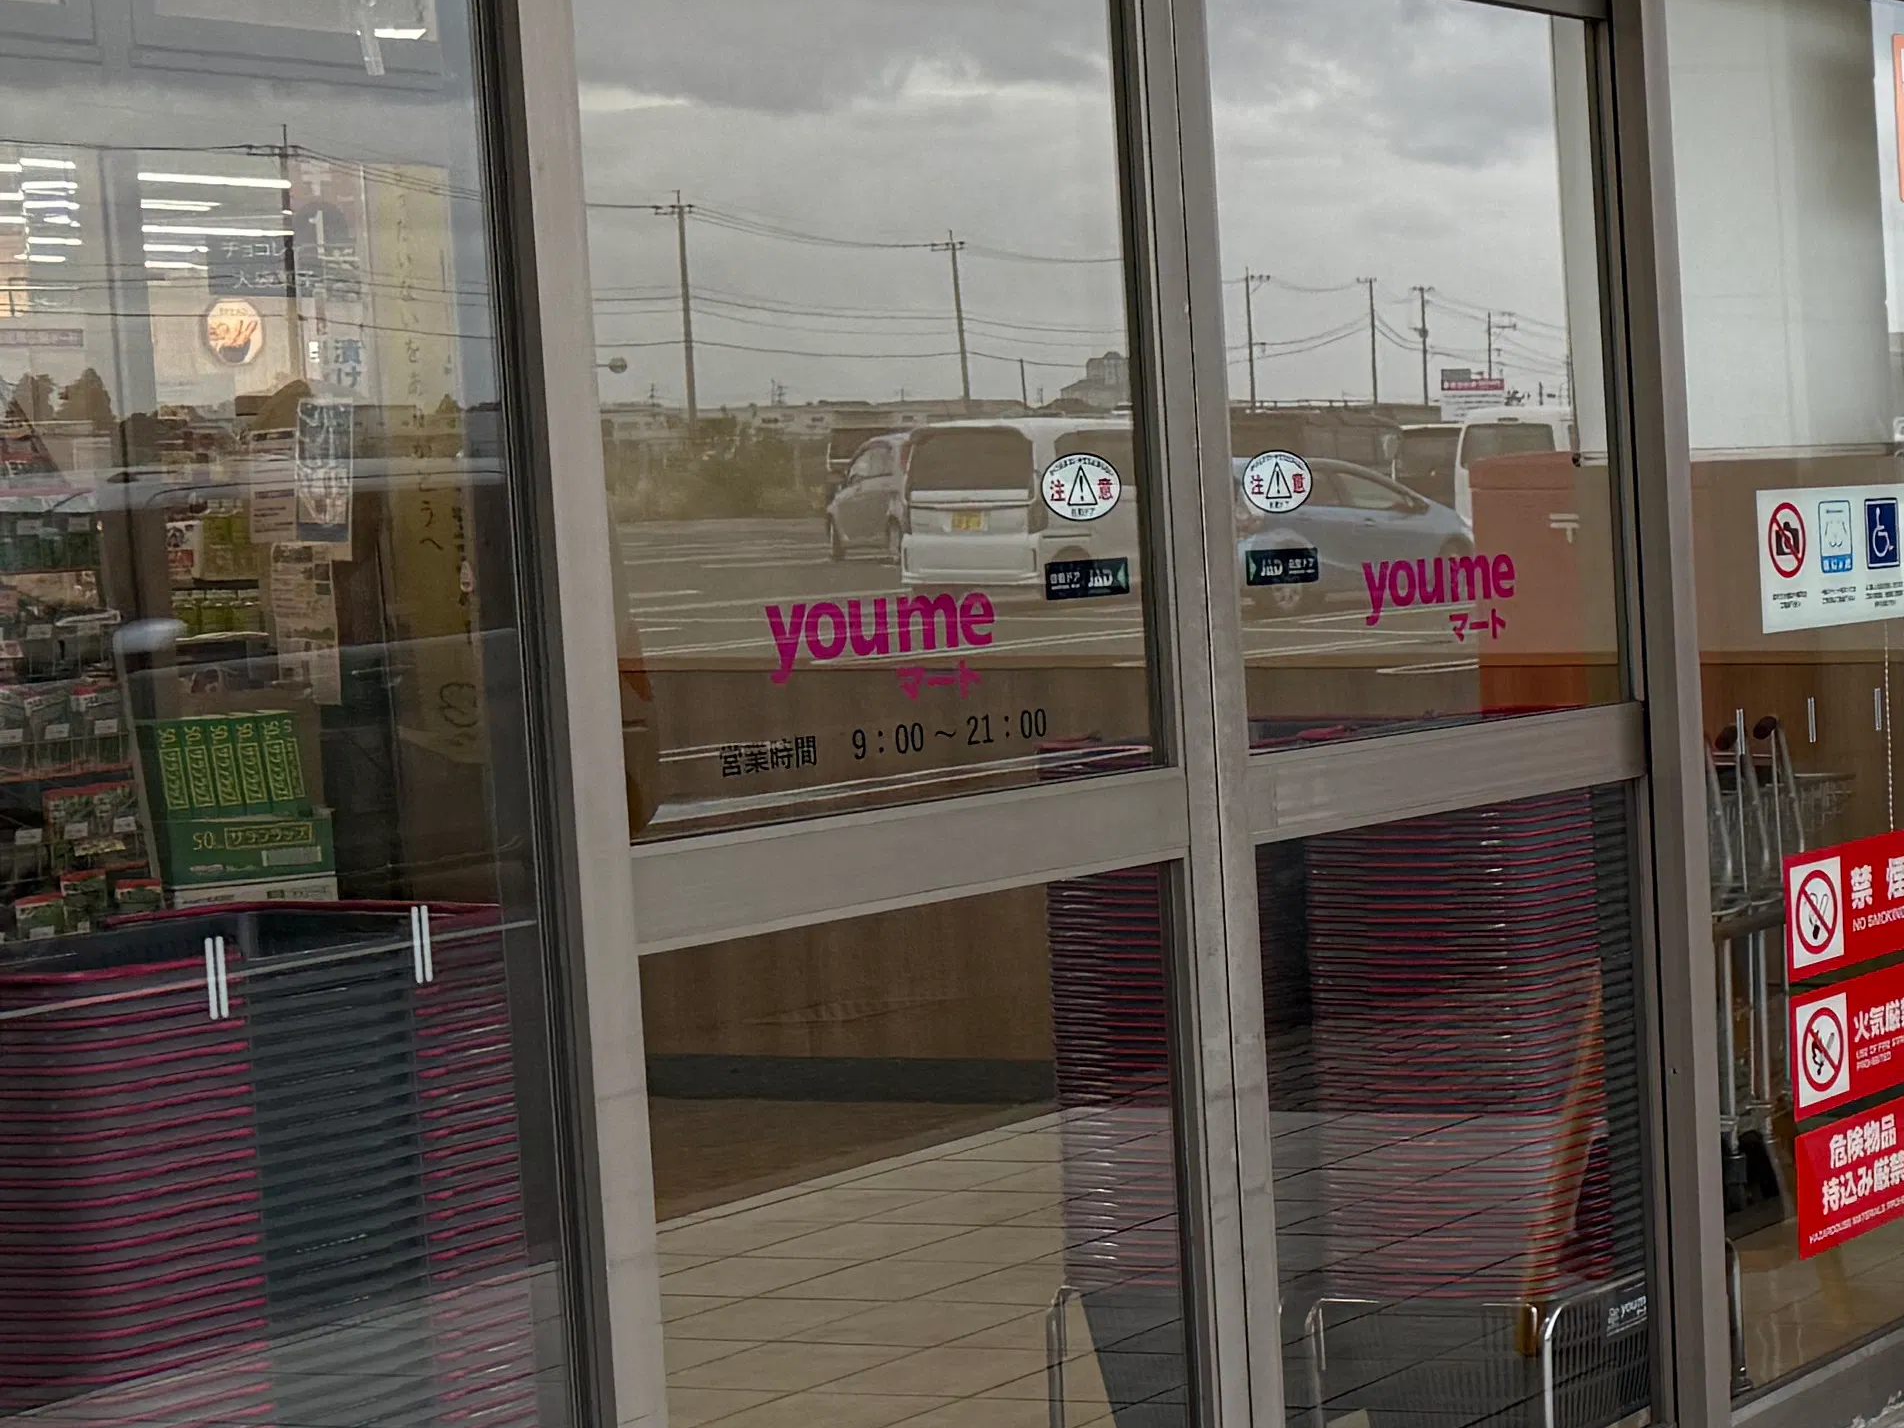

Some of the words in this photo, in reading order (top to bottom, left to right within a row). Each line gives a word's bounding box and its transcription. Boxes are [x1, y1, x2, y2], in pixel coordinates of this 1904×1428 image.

[1050, 477, 1113, 502] 注意
[1361, 553, 1516, 626] youme
[764, 591, 995, 685] youme
[1449, 608, 1506, 642] マート
[895, 659, 982, 701] マート
[718, 735, 817, 777] 営業時間
[1852, 916, 1866, 932] NO
[1829, 1113, 1897, 1169] 危険物品
[1620, 1296, 1647, 1319] youm
